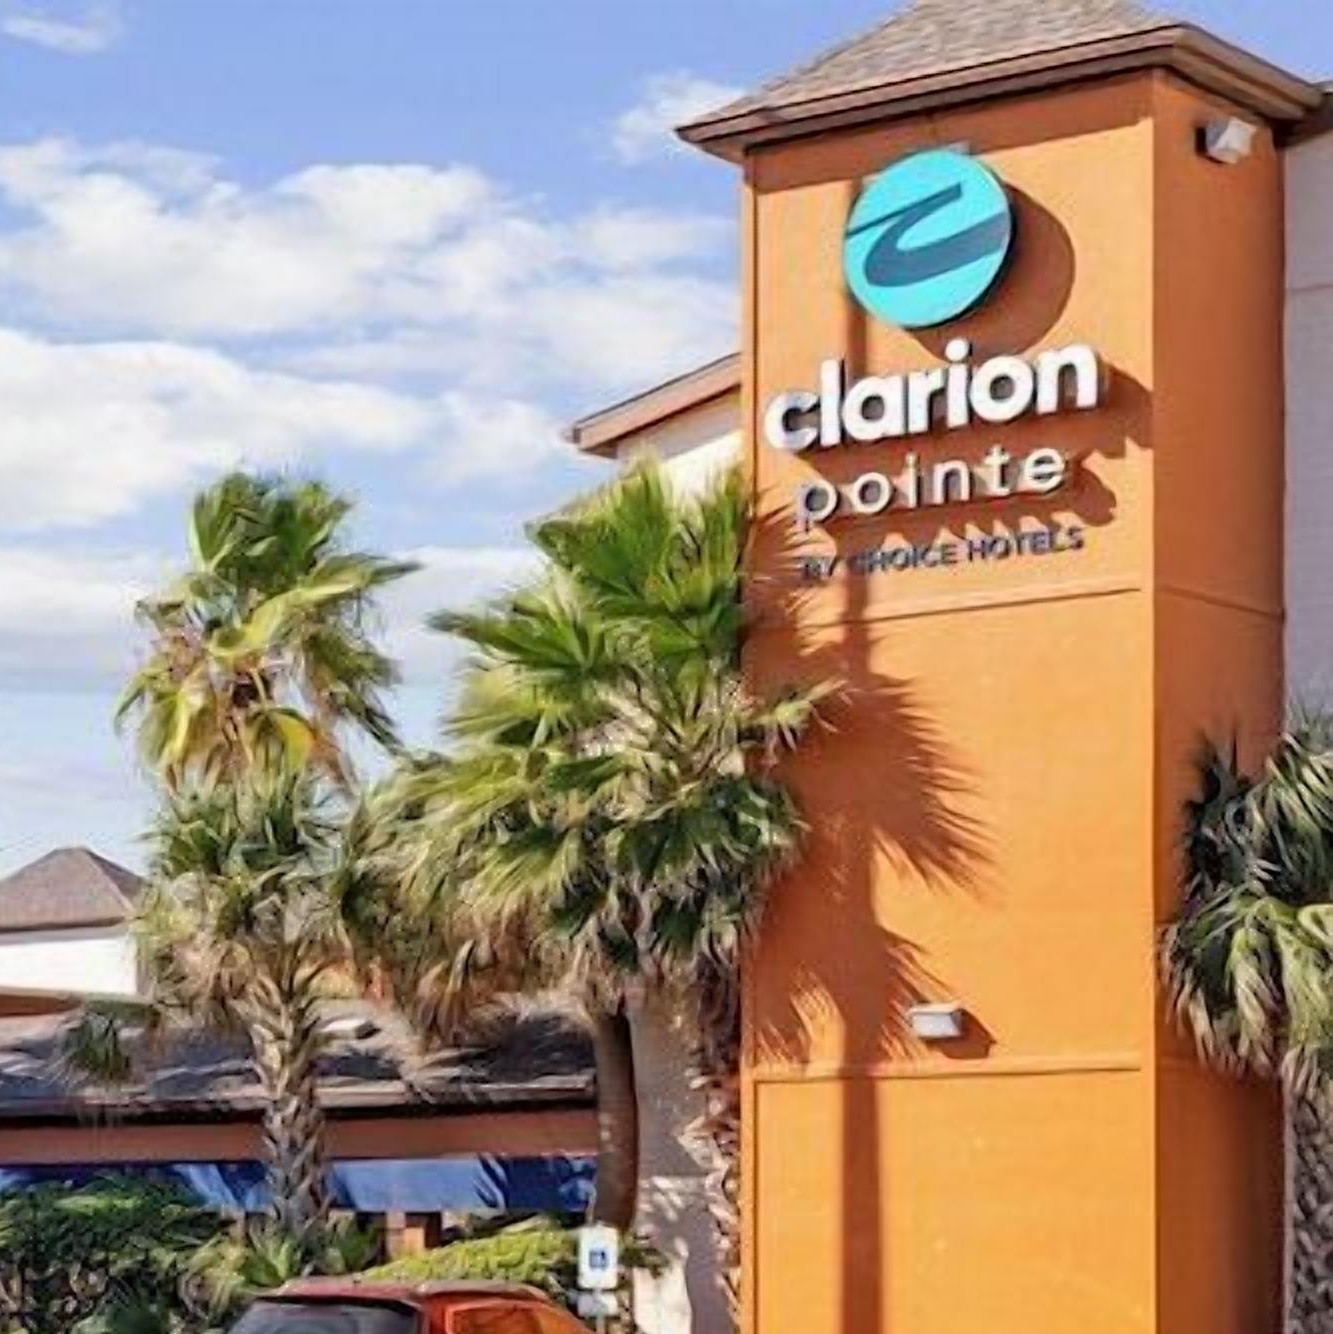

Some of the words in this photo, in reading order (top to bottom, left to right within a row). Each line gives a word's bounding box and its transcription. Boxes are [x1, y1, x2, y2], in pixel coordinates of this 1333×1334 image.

[765, 338, 1099, 450] clarion
[797, 444, 1065, 532] pointe
[847, 543, 958, 573] CHOICE
[967, 526, 1084, 562] HOTELS
